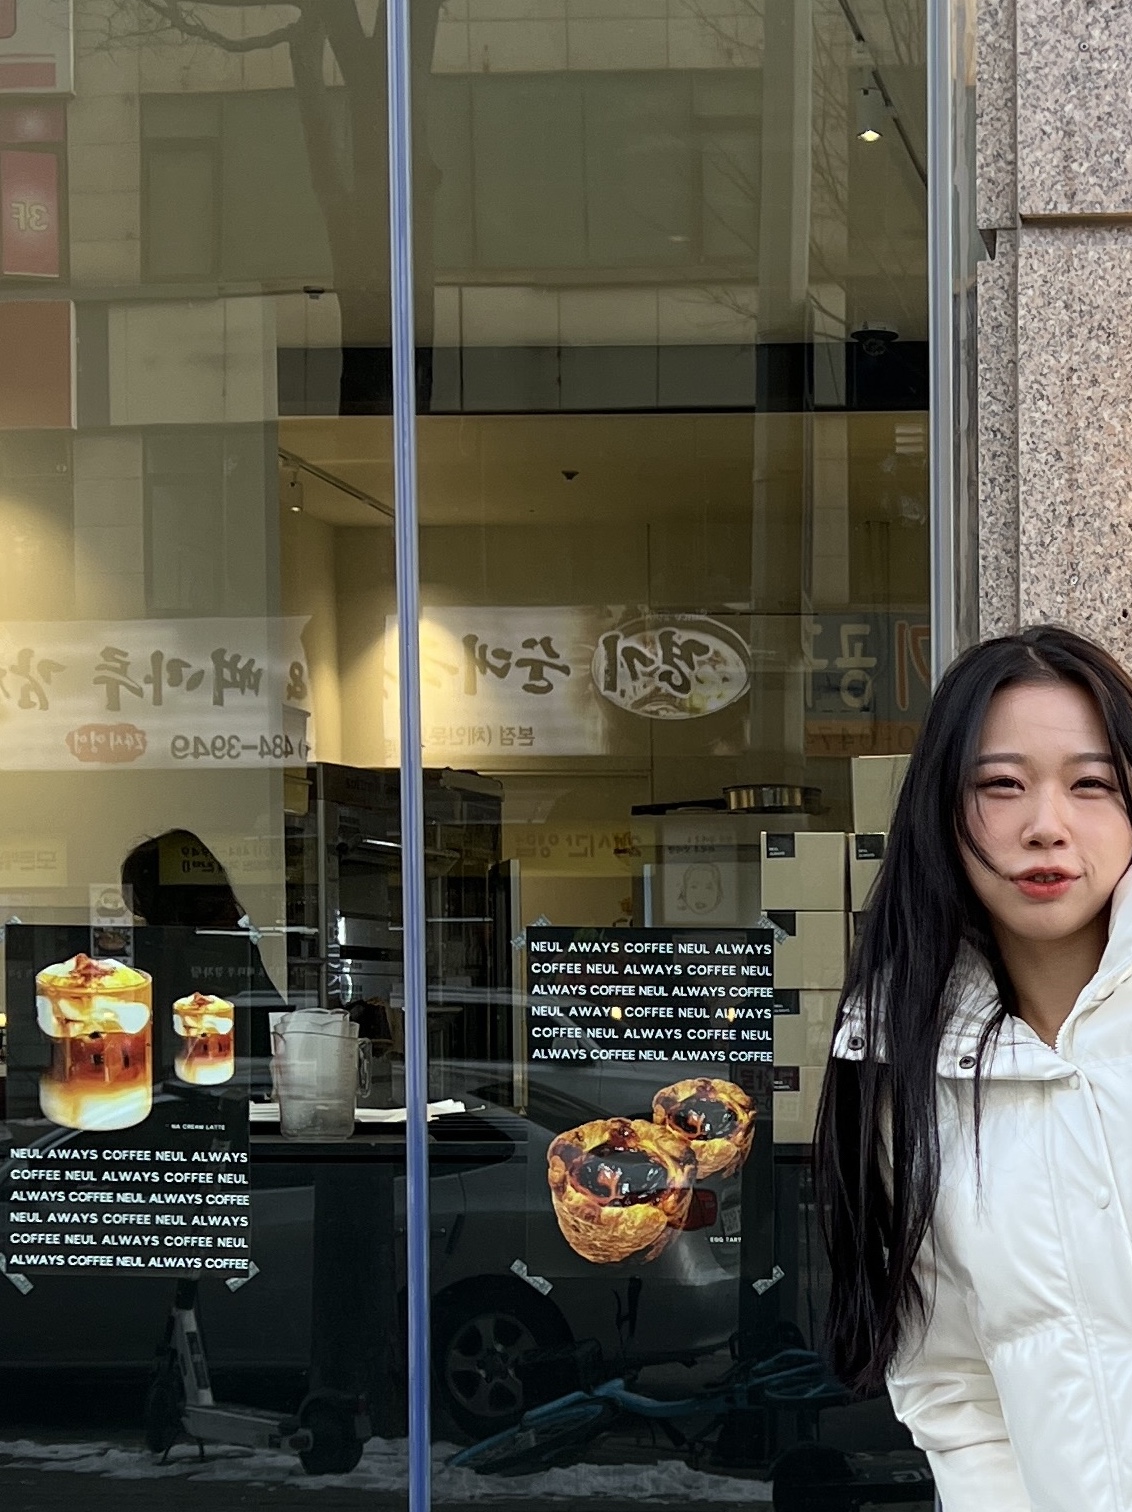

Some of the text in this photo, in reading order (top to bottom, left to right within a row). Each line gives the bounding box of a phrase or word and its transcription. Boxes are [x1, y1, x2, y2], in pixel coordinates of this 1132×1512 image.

[531, 942, 771, 954] NEUL AWAYS COFFEE NEUL ALWAYS
[532, 963, 772, 976] COFFEE NEUL ALWAYS COFFEE NEUL
[532, 985, 773, 997] ALWAYS COFFEE NEUL ALWAYS COFFEE
[532, 1006, 564, 1016] NEUL
[569, 1007, 620, 1018] AWAY
[625, 1007, 673, 1017] COFFEE
[679, 1008, 710, 1018] NEUL
[532, 1028, 771, 1040] COFFEE NEUL ALWAYS COFFEE NEUL
[533, 1049, 772, 1061] ALWAYS COFFEE NEUL ALWAYS COFFEE
[11, 1149, 247, 1162] NEUL AWAYS COFFEE NEUL ALWAYS
[11, 1170, 248, 1184] COFFEE NEUL ALWAYS COFFEE NEUL
[10, 1191, 249, 1205] ALWAYS COFFEE NEUL ALWAYS COFFEE
[10, 1212, 248, 1226] NEUL AWAYS COFFEE NEUL ALWAYS
[10, 1233, 248, 1248] COFFEE NEUL ALWAYS COFFEE NEUL
[10, 1255, 248, 1269] ALWAYS COFFEE NEUL ALWAYS COFFEE
